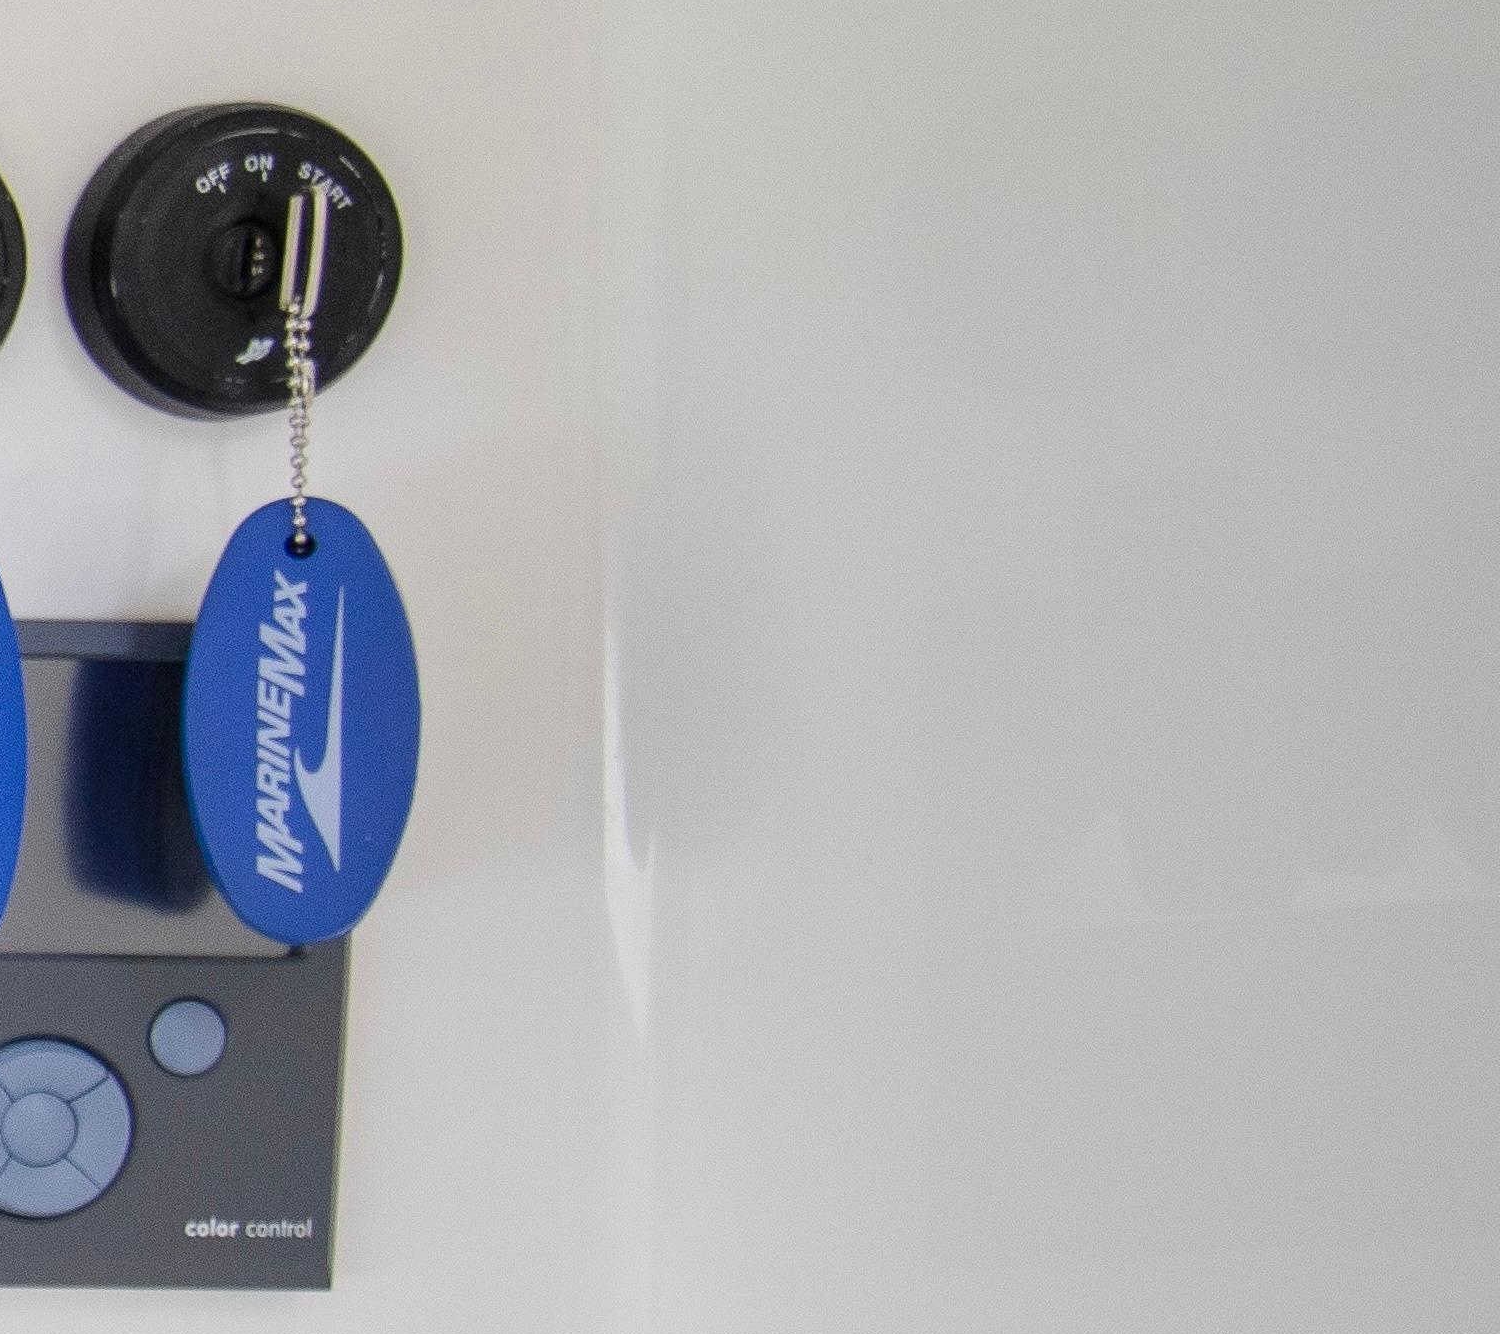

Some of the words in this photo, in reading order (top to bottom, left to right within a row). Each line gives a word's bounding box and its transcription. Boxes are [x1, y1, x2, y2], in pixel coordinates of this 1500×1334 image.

[245, 154, 275, 172] ON
[196, 163, 232, 193] OFF
[298, 163, 353, 209] START
[184, 1219, 238, 1237] color
[246, 1219, 313, 1239] control
